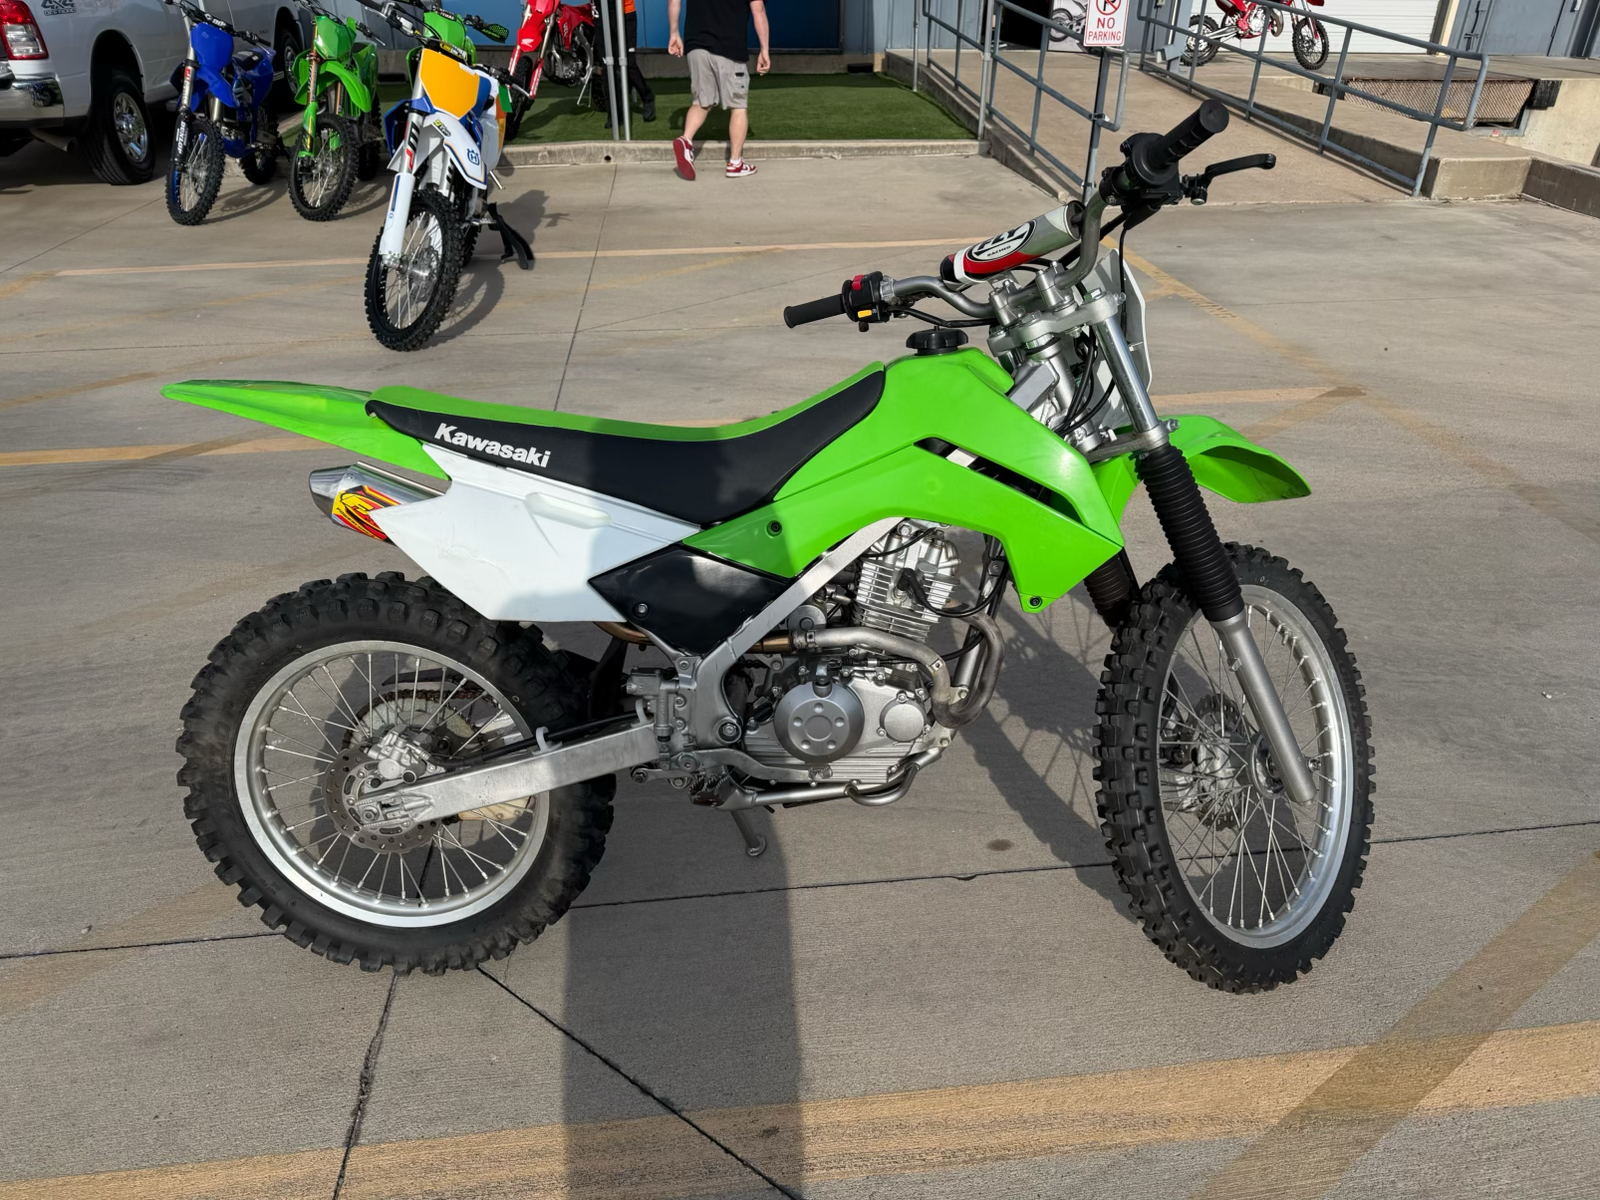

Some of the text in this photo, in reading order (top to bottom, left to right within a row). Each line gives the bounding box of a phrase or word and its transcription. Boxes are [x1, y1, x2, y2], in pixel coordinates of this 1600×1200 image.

[1096, 17, 1116, 29] NO
[1088, 31, 1122, 41] PARKING
[177, 121, 186, 155] DUNLOP
[986, 244, 1012, 257] RACING
[434, 422, 551, 468] Kawasaki
